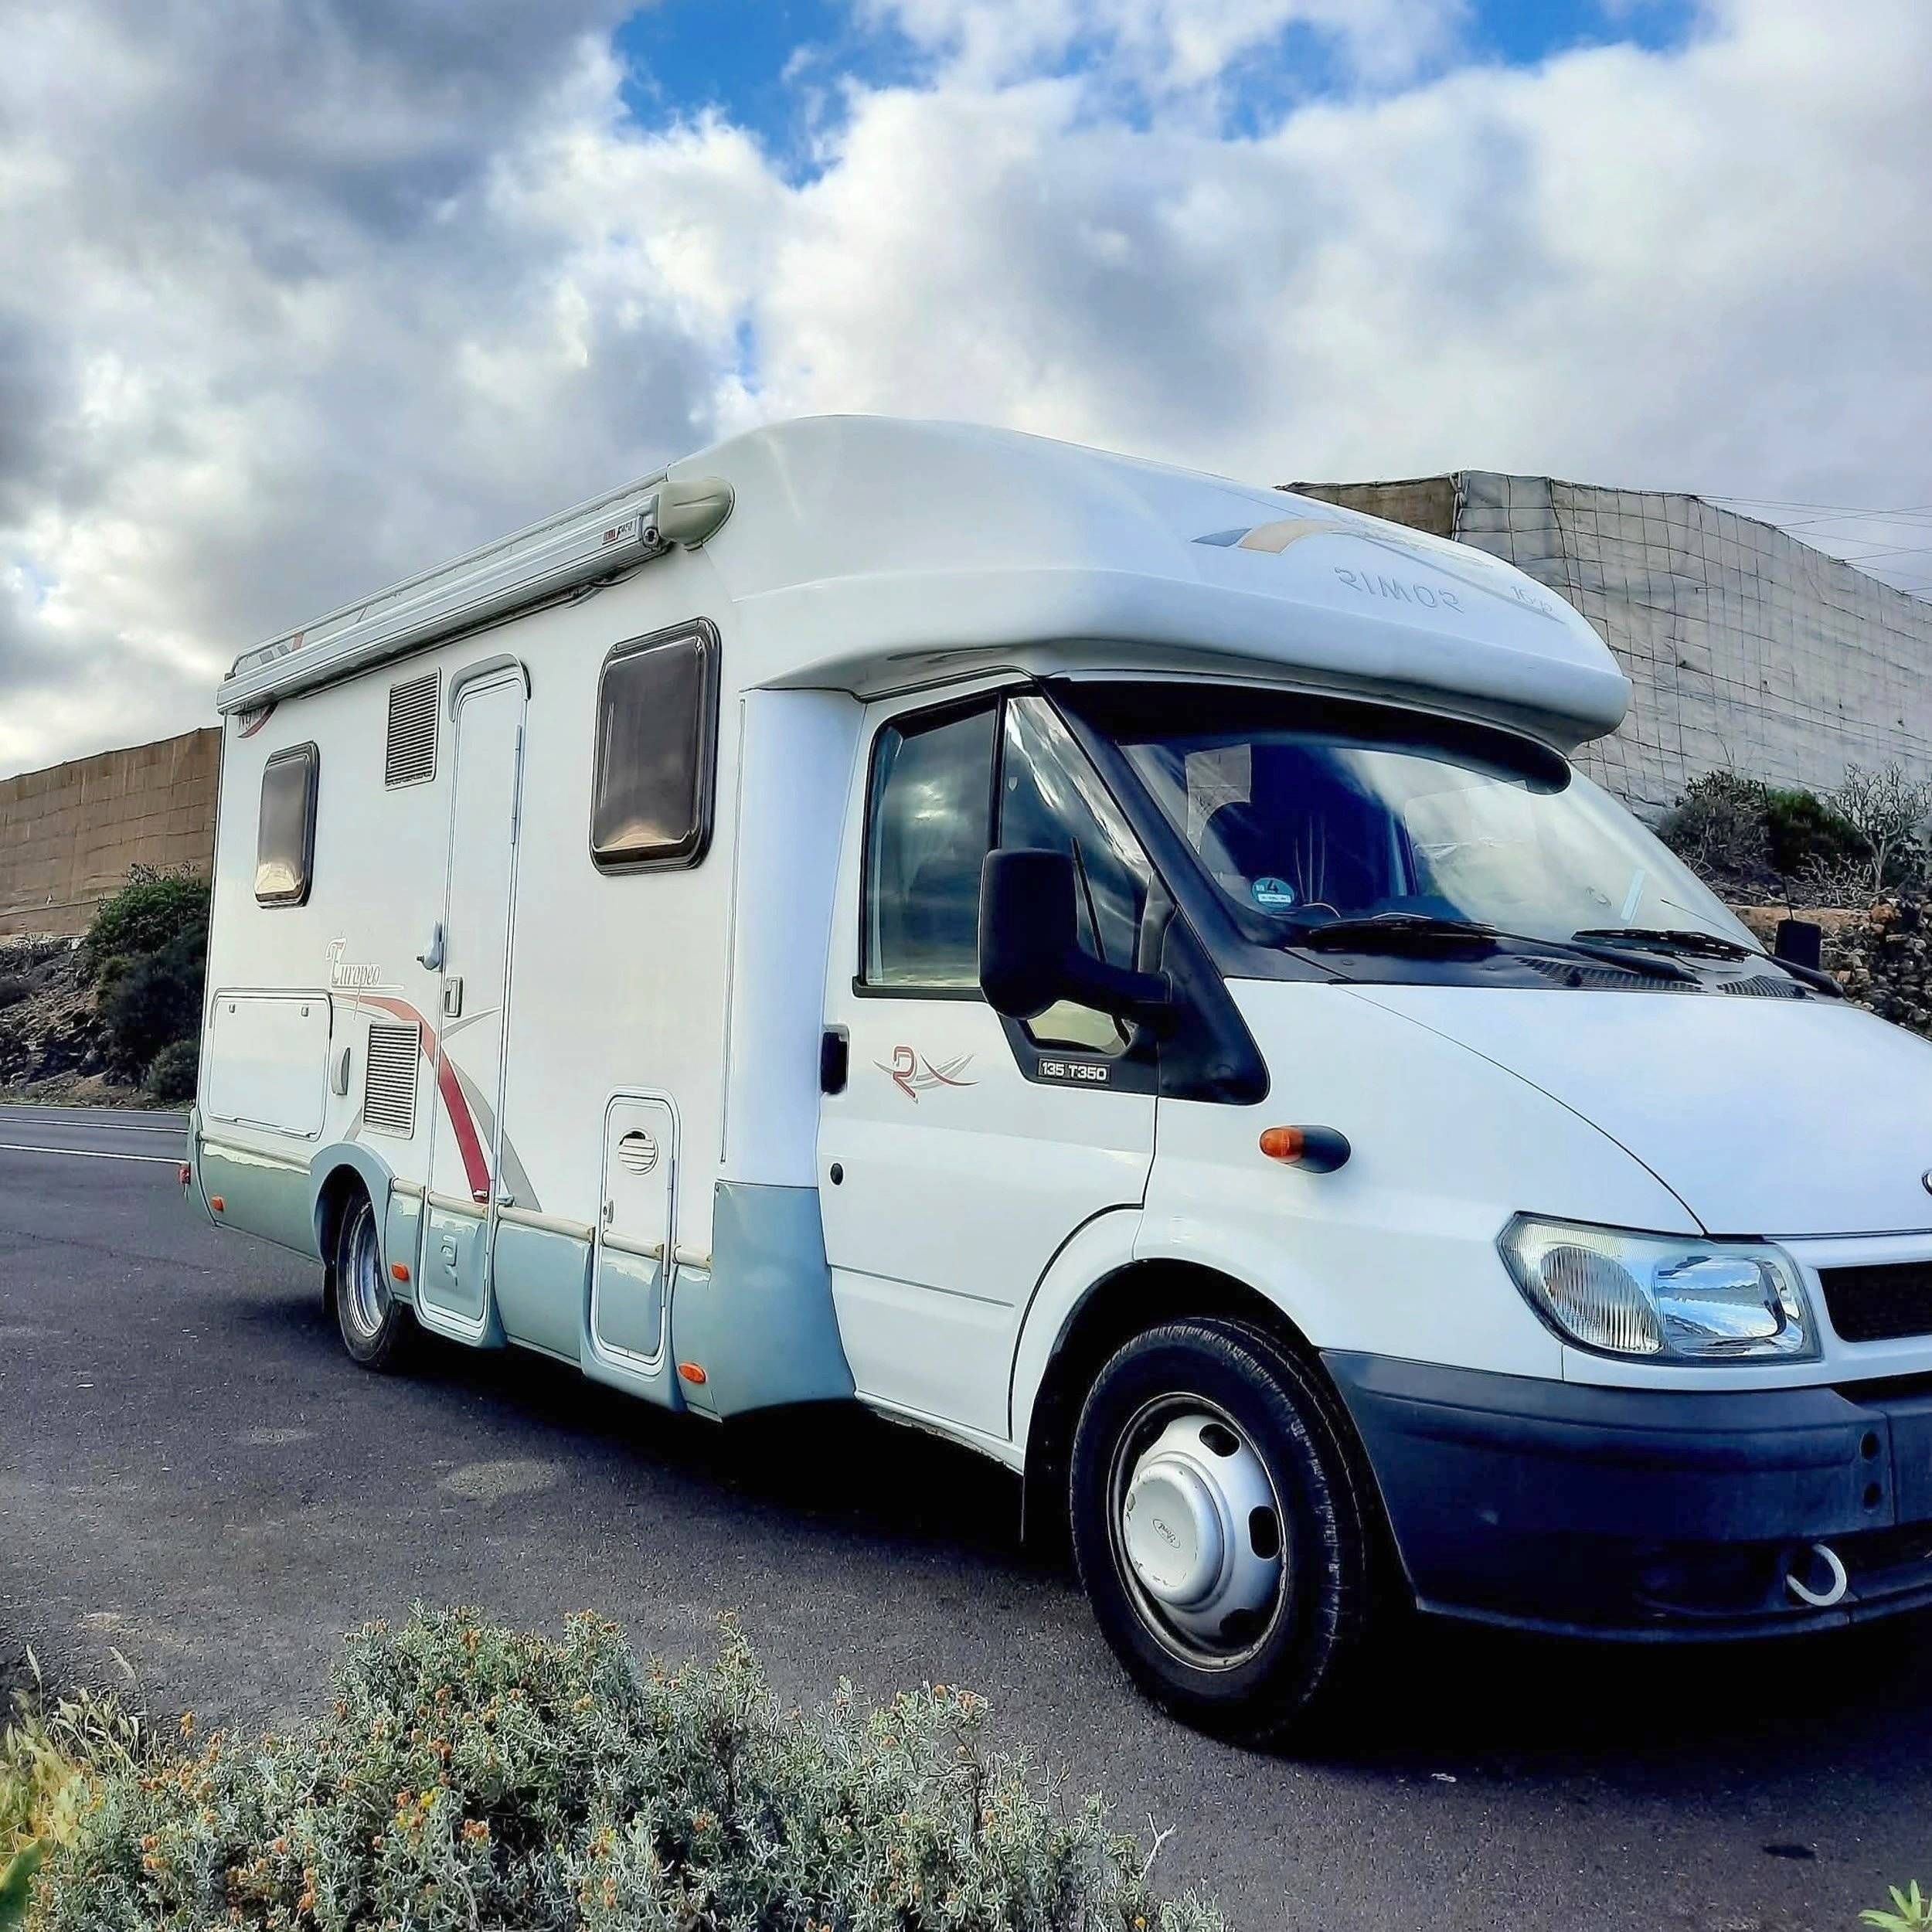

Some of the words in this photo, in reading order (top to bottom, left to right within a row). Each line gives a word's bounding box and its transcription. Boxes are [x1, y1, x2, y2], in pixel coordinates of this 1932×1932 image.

[1334, 566, 1465, 614] RIMOR
[1042, 1061, 1065, 1077] 135
[1068, 1064, 1107, 1081] T350
